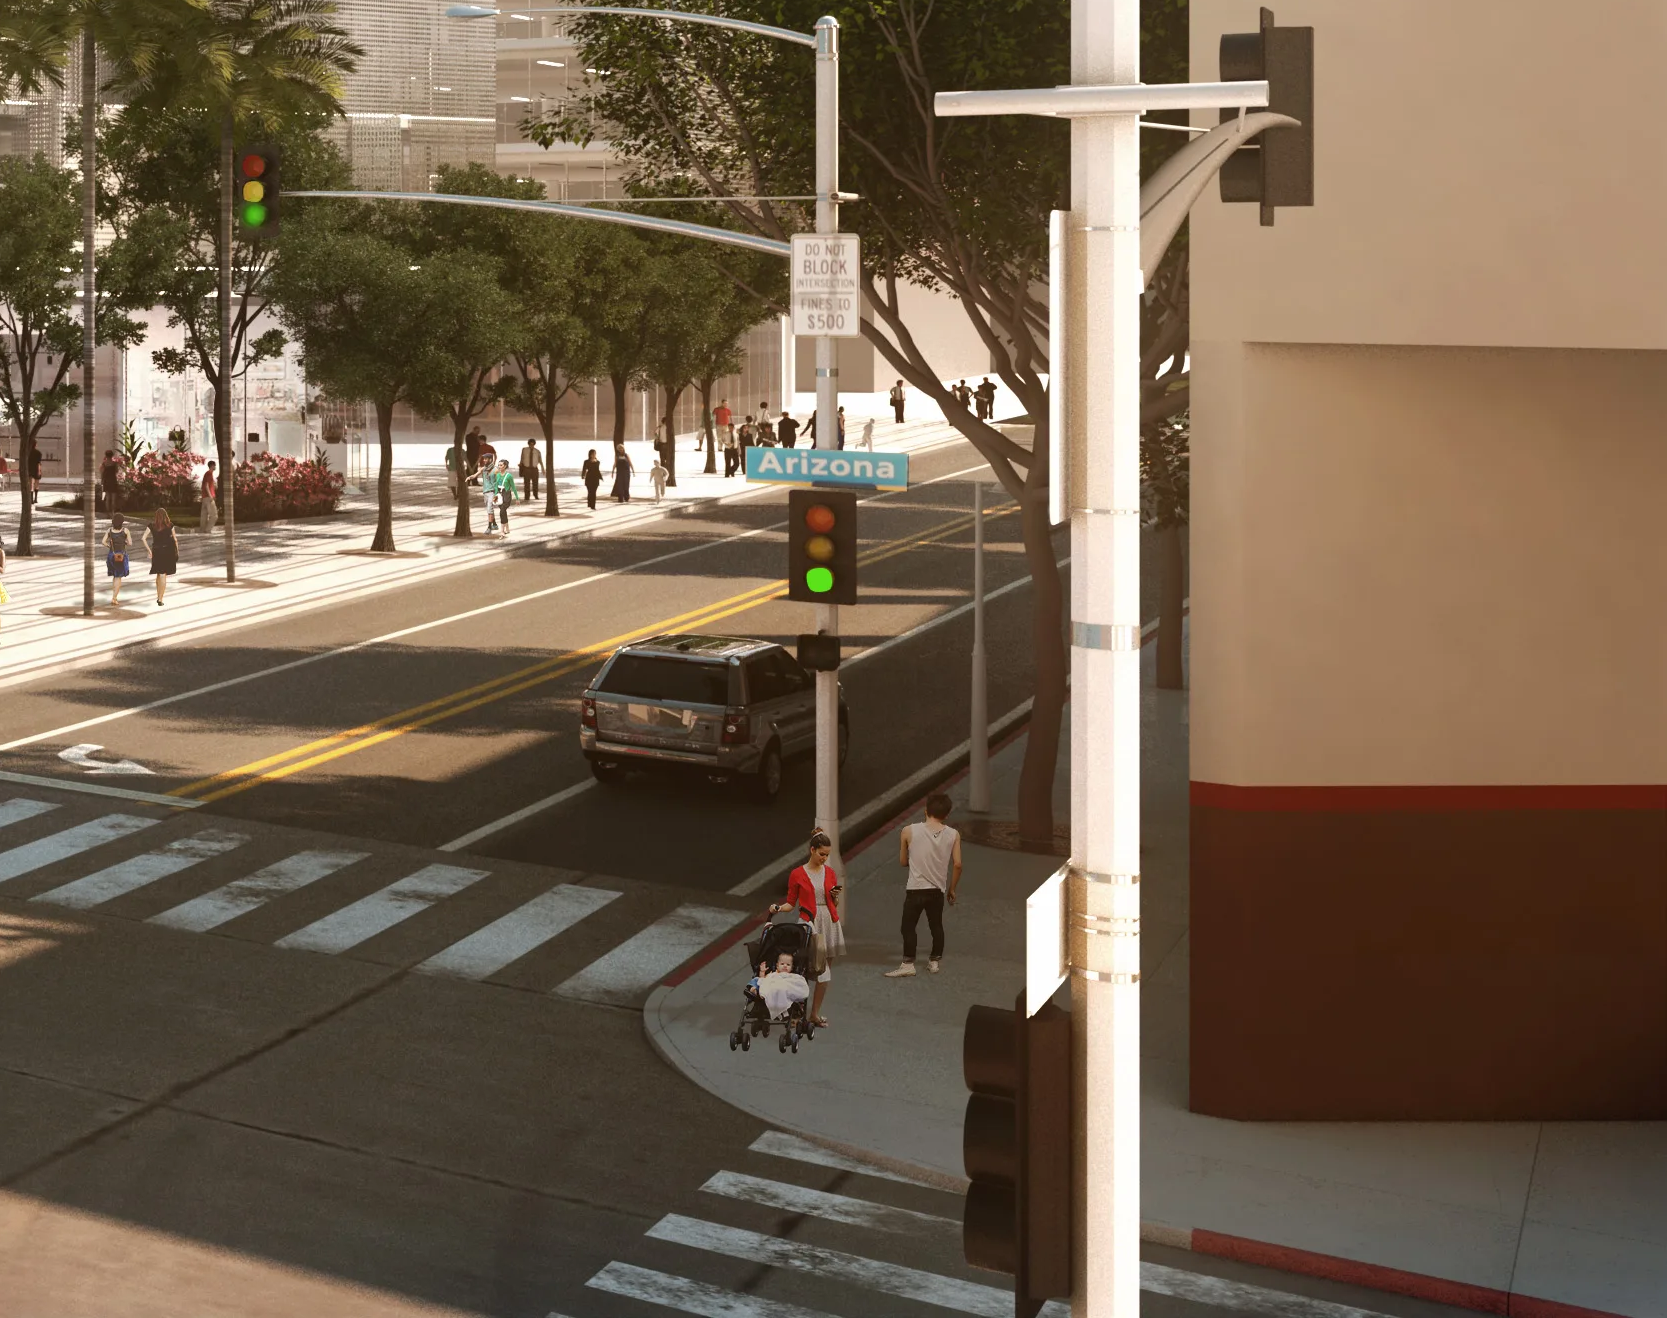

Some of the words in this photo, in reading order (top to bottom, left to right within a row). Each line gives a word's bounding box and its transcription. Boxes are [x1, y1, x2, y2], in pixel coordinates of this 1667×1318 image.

[805, 244, 820, 256] DO
[825, 244, 845, 256] NOT
[803, 260, 847, 275] BLOCK
[796, 278, 855, 289] INTERSECTION
[801, 298, 833, 311] FINES
[838, 298, 850, 310] TO
[807, 314, 845, 330] $500
[758, 450, 895, 479] Arizona
